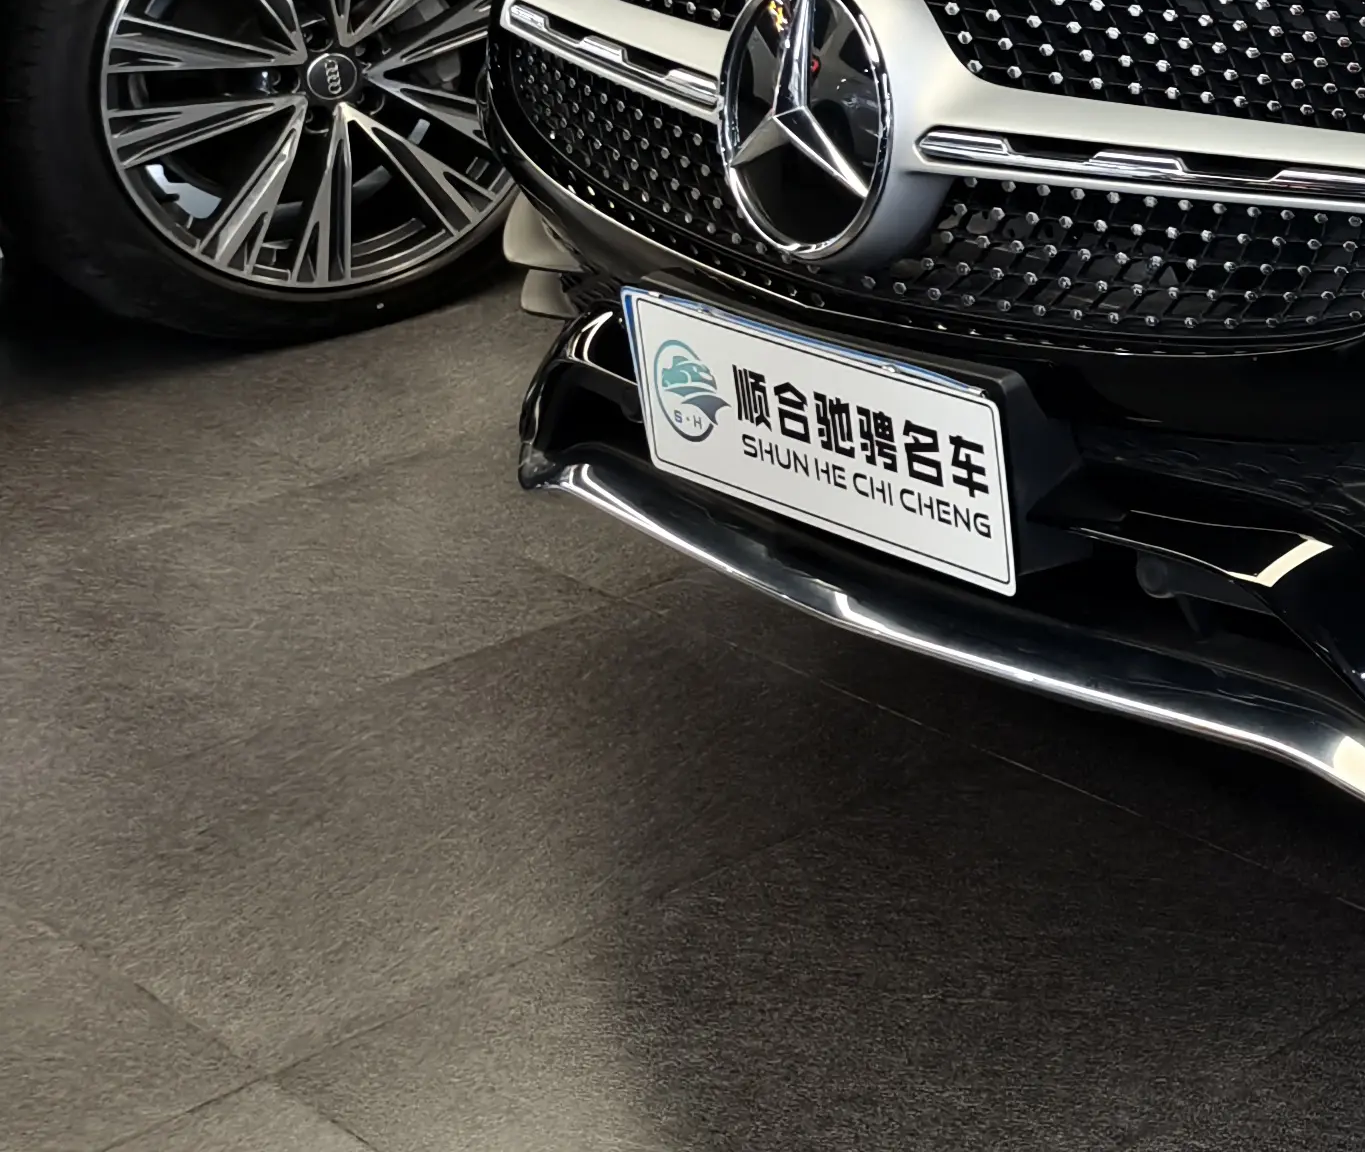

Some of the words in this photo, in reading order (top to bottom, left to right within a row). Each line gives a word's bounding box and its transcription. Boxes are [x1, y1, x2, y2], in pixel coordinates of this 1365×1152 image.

[732, 364, 990, 499] 顺合驰骋名车
[742, 433, 810, 477] SHUN
[814, 457, 847, 490] HE
[853, 472, 893, 506] CHI
[900, 488, 992, 539] CHENG
